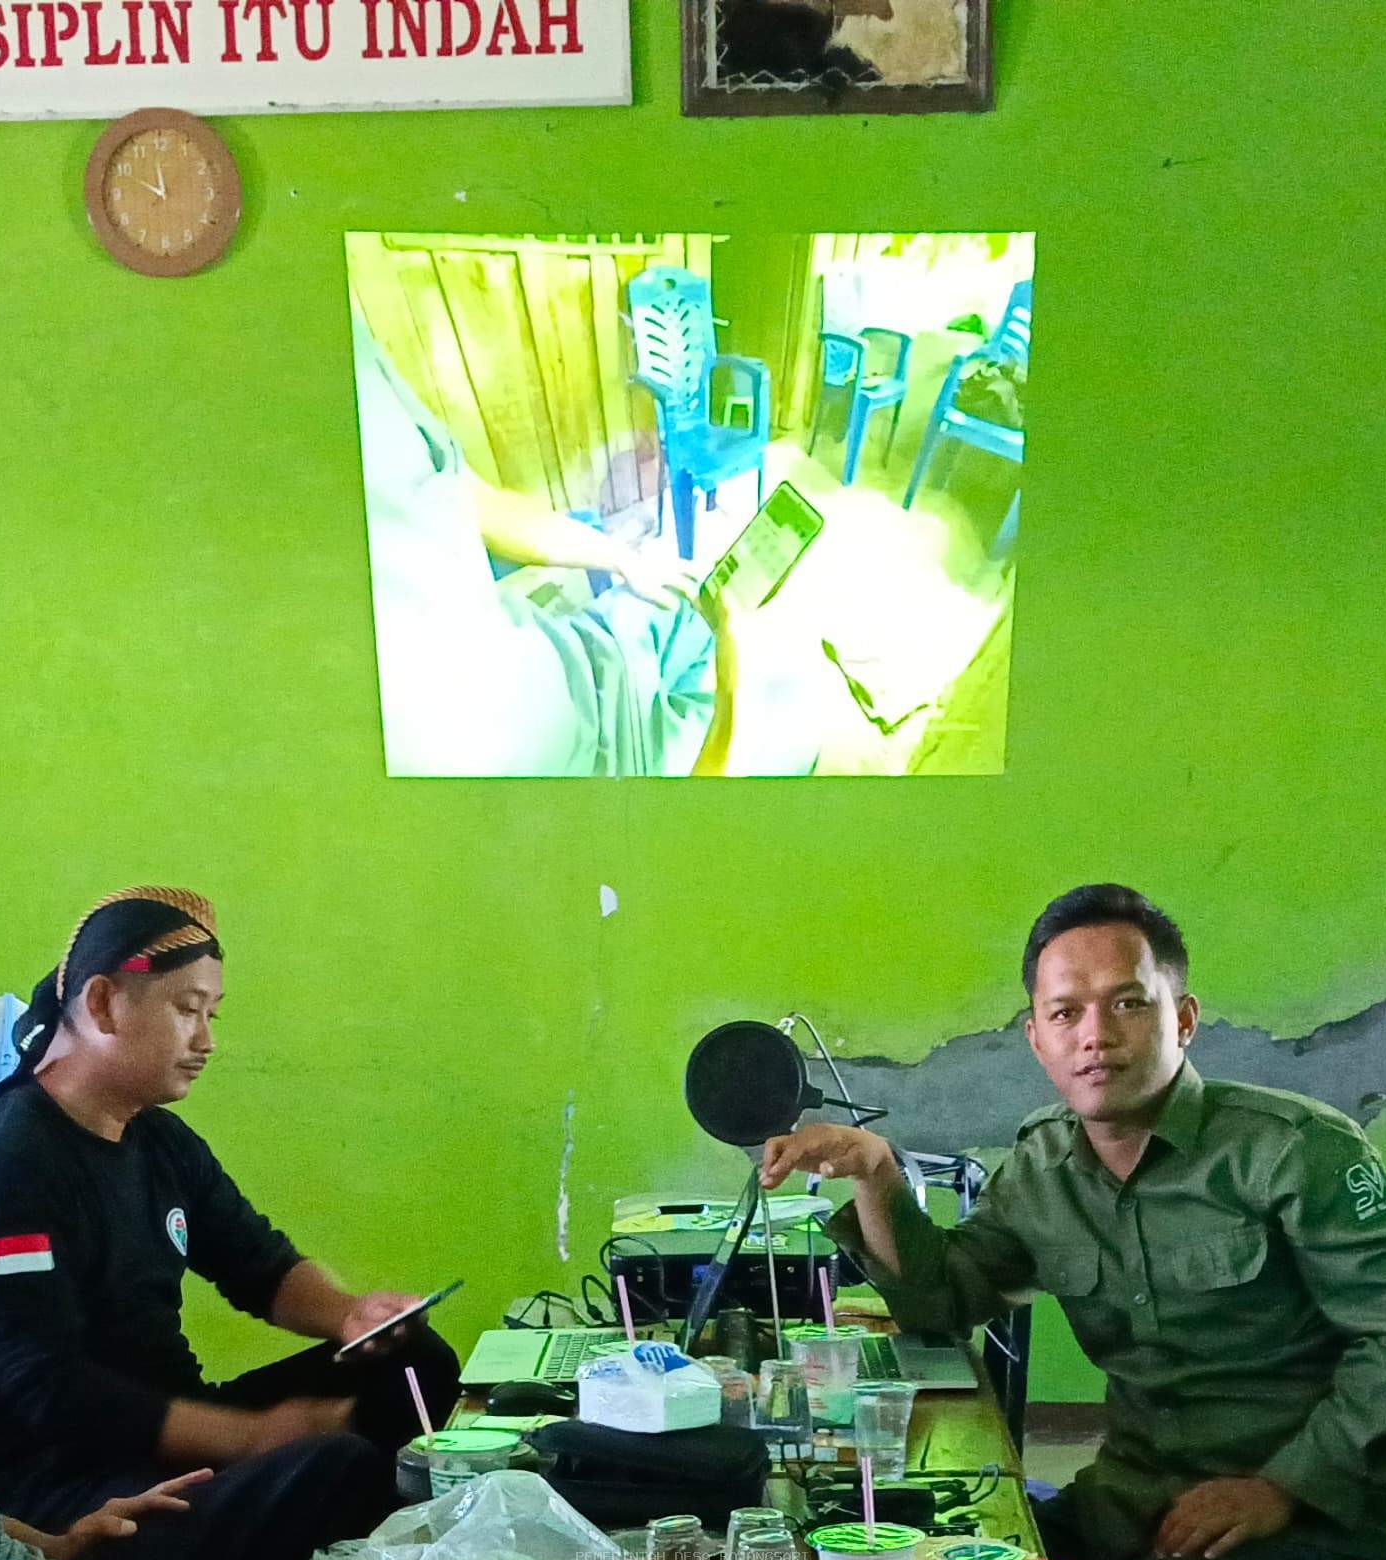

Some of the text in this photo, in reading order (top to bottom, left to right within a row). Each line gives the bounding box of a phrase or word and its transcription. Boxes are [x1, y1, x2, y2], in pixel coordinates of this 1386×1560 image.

[220, 0, 335, 63] ITU
[360, 0, 584, 60] INDAH
[154, 137, 166, 150] 12
[133, 145, 146, 159] 11
[117, 163, 132, 176] 10
